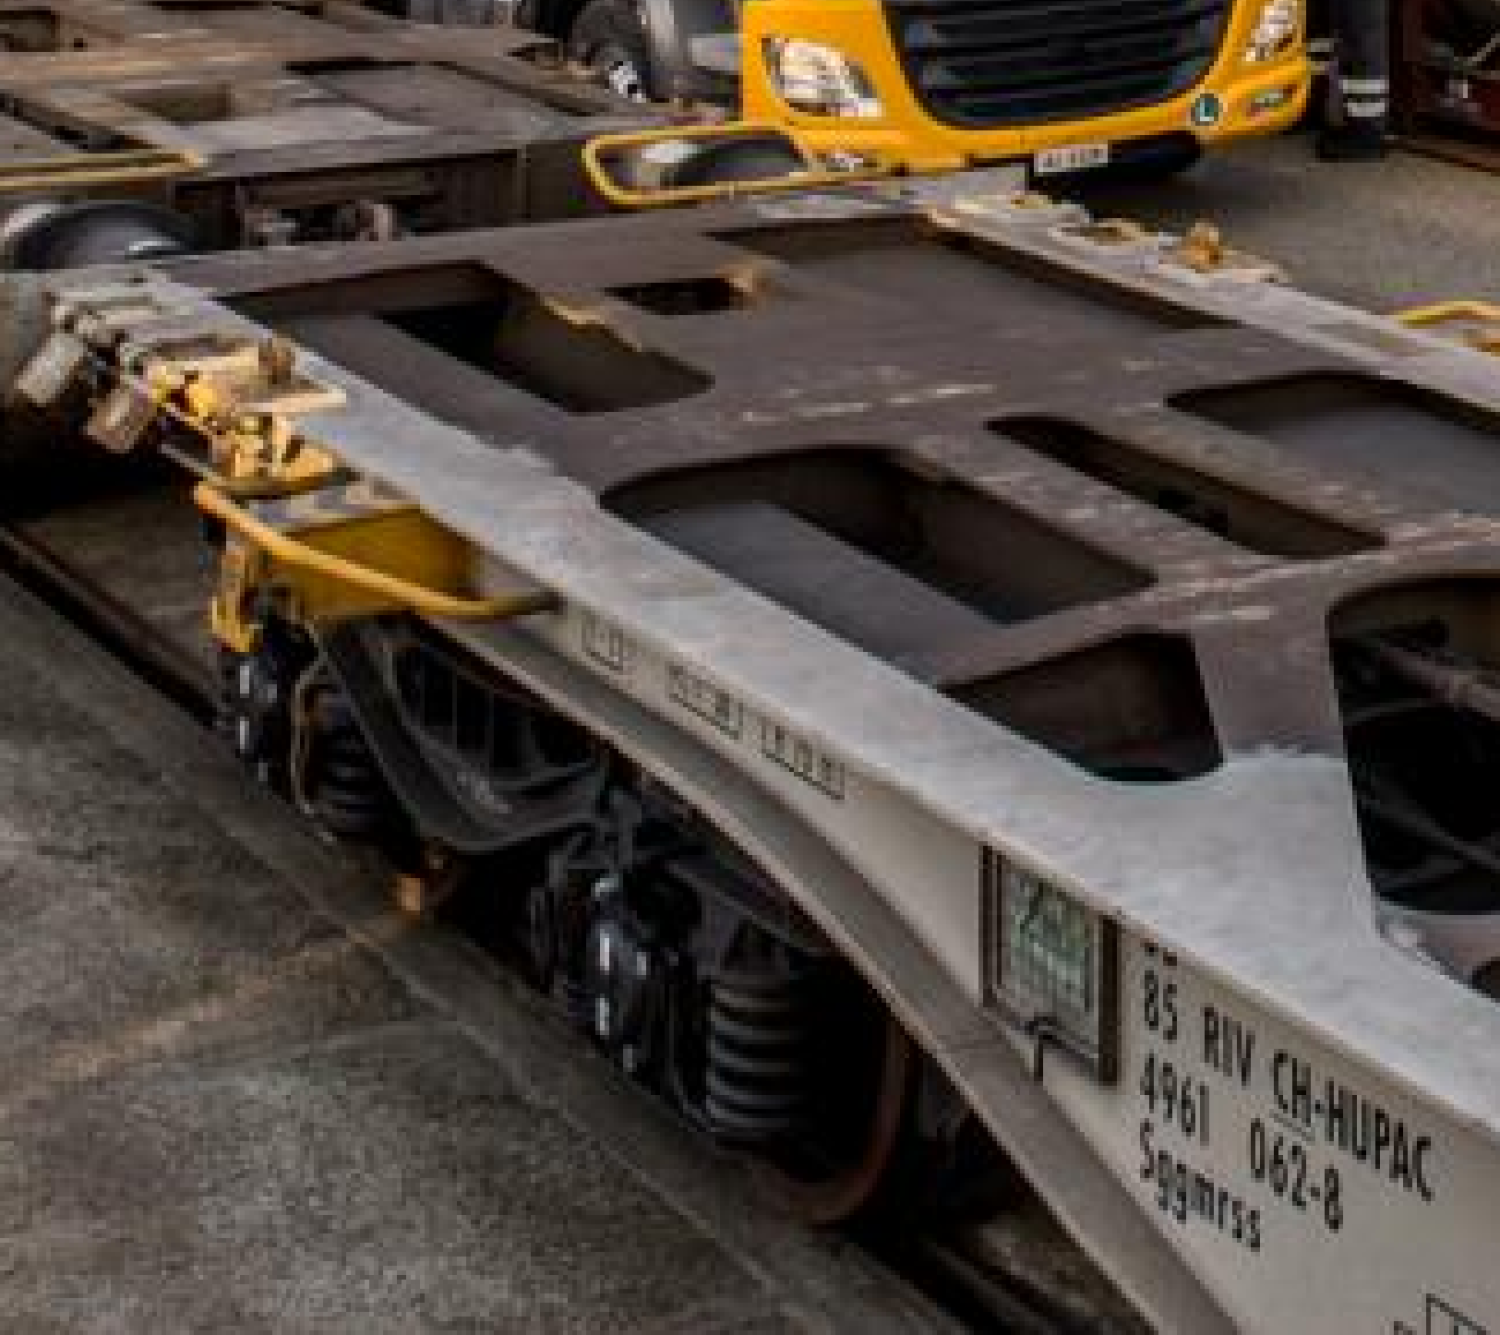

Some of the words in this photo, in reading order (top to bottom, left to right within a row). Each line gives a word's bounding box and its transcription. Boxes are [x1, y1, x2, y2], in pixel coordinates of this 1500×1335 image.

[1139, 1053, 1212, 1145] 4961
[1248, 1119, 1345, 1233] 062-8
[1141, 969, 1179, 1043] 85
[1202, 1006, 1256, 1089] RIV
[1271, 1051, 1434, 1202] CH-HUPAC
[1139, 1127, 1263, 1253] Sggmrss
